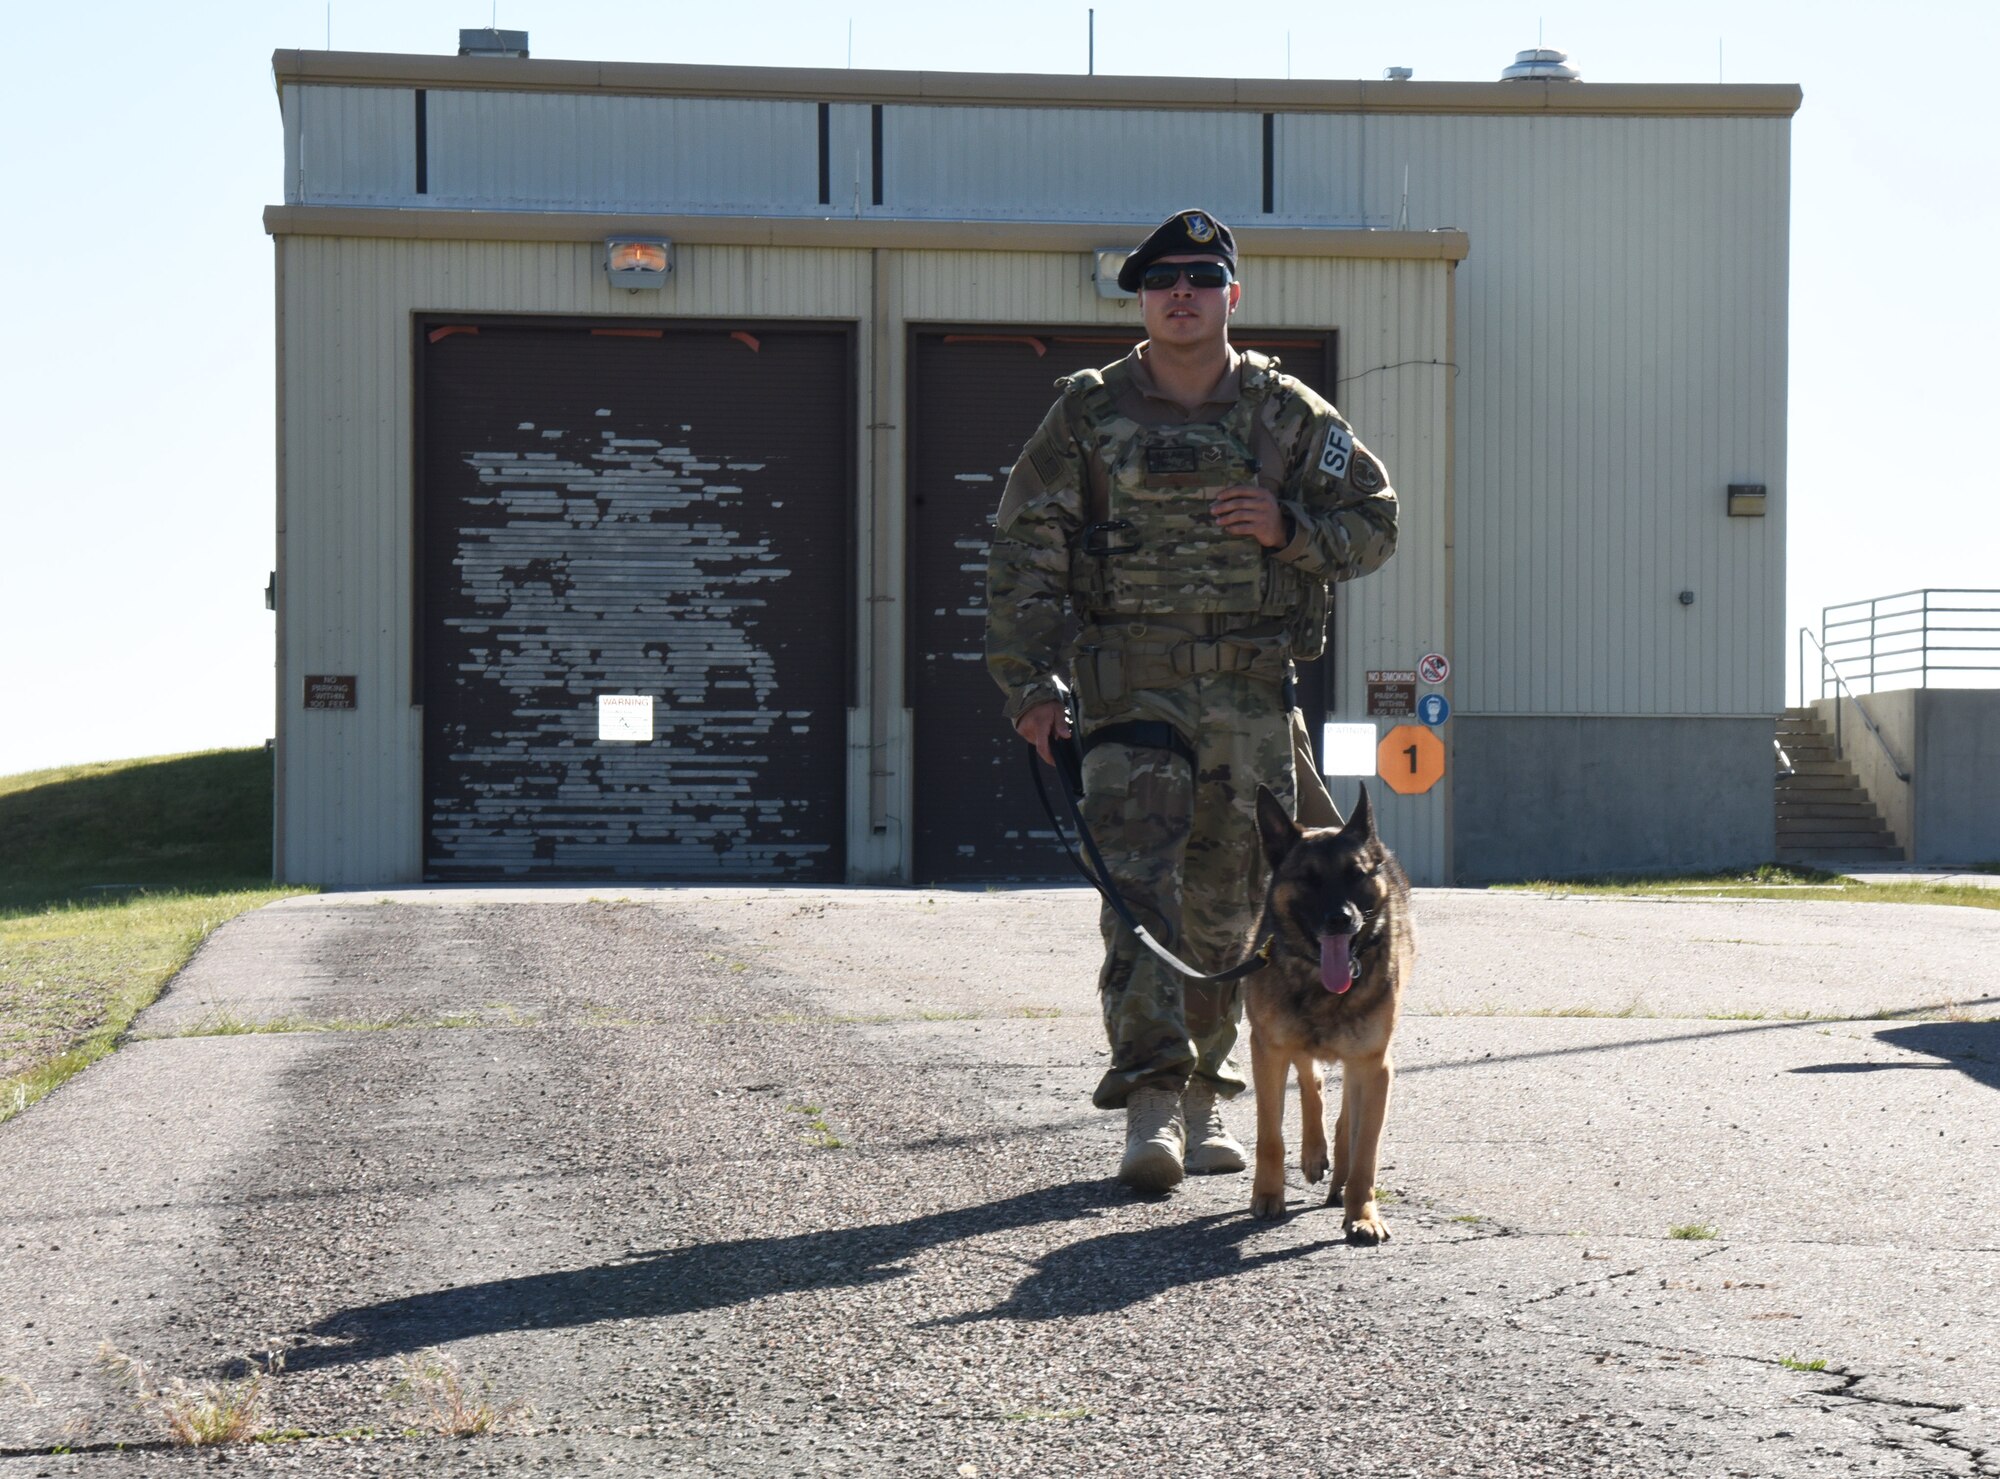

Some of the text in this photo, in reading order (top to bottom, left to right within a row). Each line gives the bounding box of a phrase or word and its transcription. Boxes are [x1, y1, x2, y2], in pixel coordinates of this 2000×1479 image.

[1324, 431, 1348, 471] SF
[323, 676, 337, 684] NO
[1368, 671, 1415, 682] NO SMOKING
[311, 684, 348, 692] PARKING
[315, 692, 345, 700] WITHIN
[1374, 691, 1408, 700] PARKING
[328, 700, 350, 708] FEET
[602, 698, 649, 706] WARNING
[1373, 707, 1409, 715] 100 FEET
[1403, 744, 1417, 774] 1
